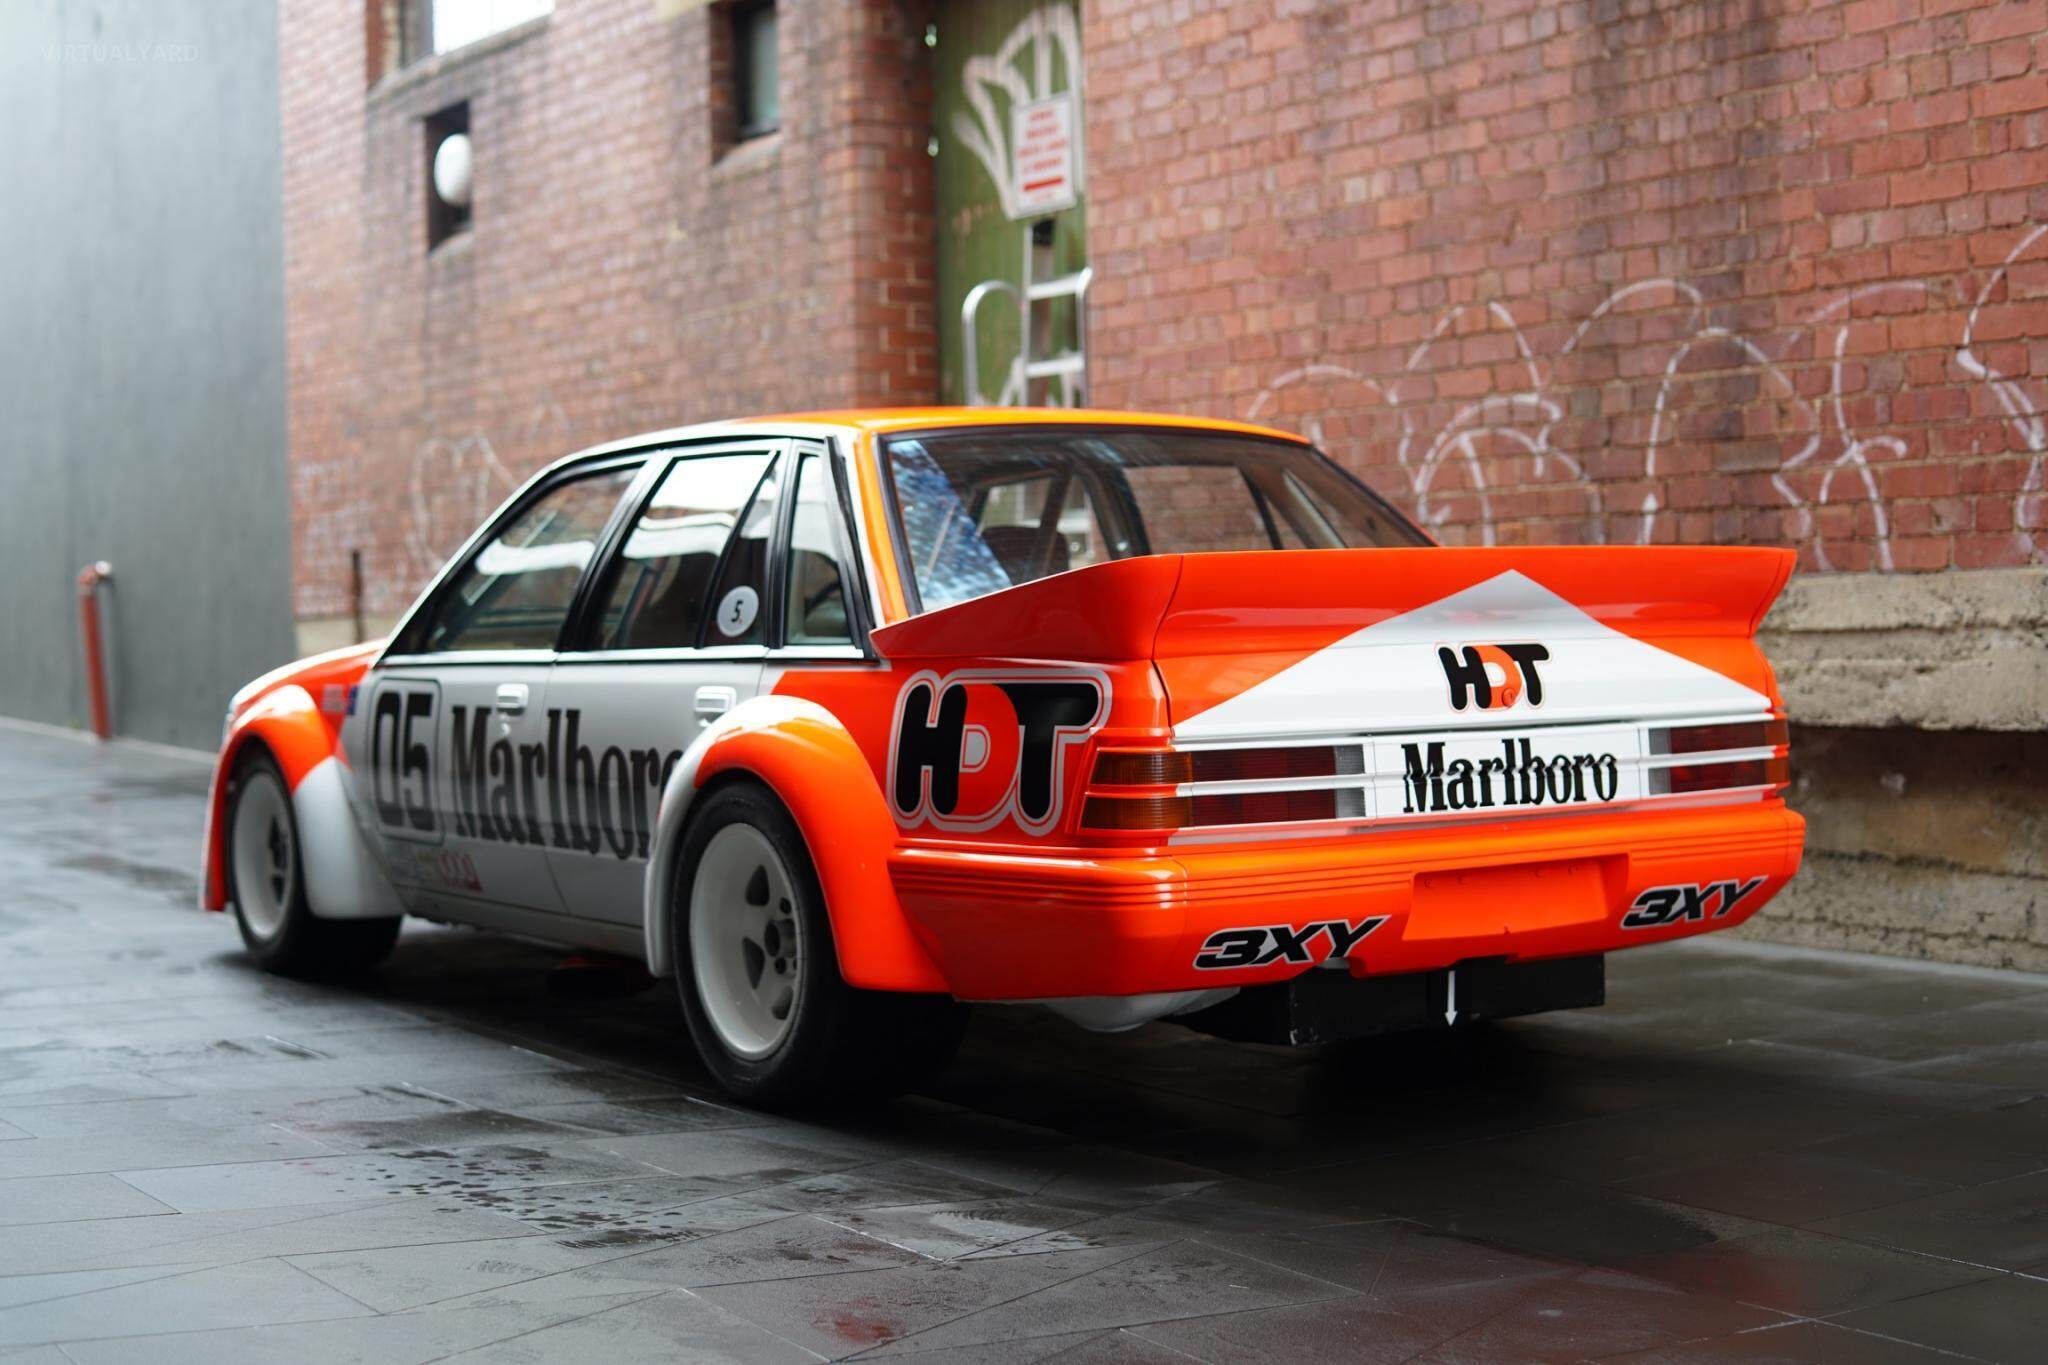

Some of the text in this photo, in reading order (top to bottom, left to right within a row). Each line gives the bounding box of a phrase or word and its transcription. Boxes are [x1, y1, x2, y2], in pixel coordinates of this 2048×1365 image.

[1438, 643, 1549, 709] HDT
[373, 692, 435, 832] 05
[892, 674, 1106, 829] HDT
[1401, 738, 1617, 813] Marlboro
[1620, 875, 1768, 930] 3XY
[1193, 914, 1391, 970] 3XY
